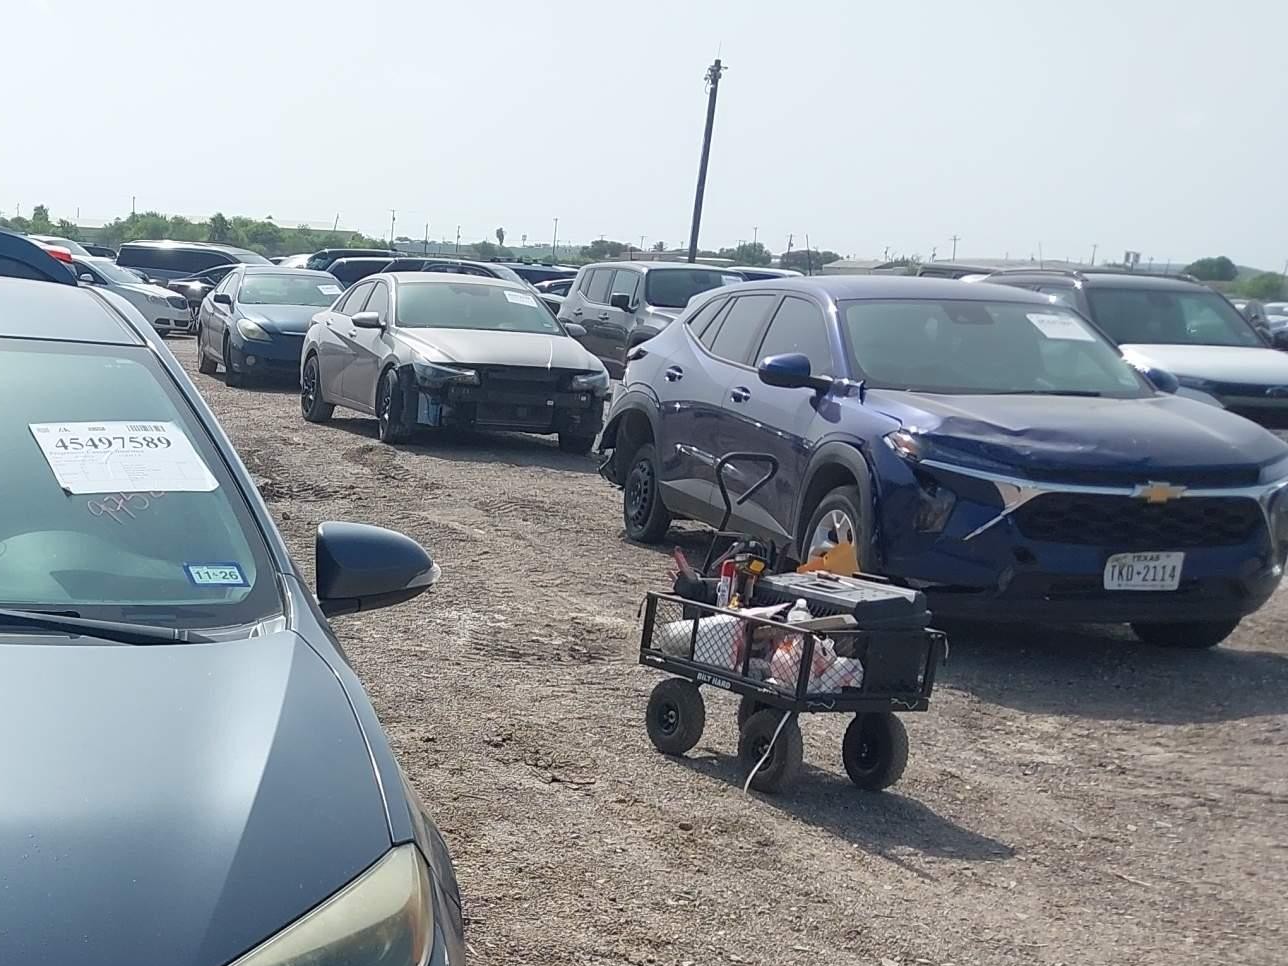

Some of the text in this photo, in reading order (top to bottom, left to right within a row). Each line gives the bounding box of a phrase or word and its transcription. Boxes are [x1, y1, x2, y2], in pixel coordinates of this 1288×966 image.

[55, 436, 172, 450] 45497589
[87, 491, 165, 525] 975
[697, 672, 731, 689] BILT HARD
